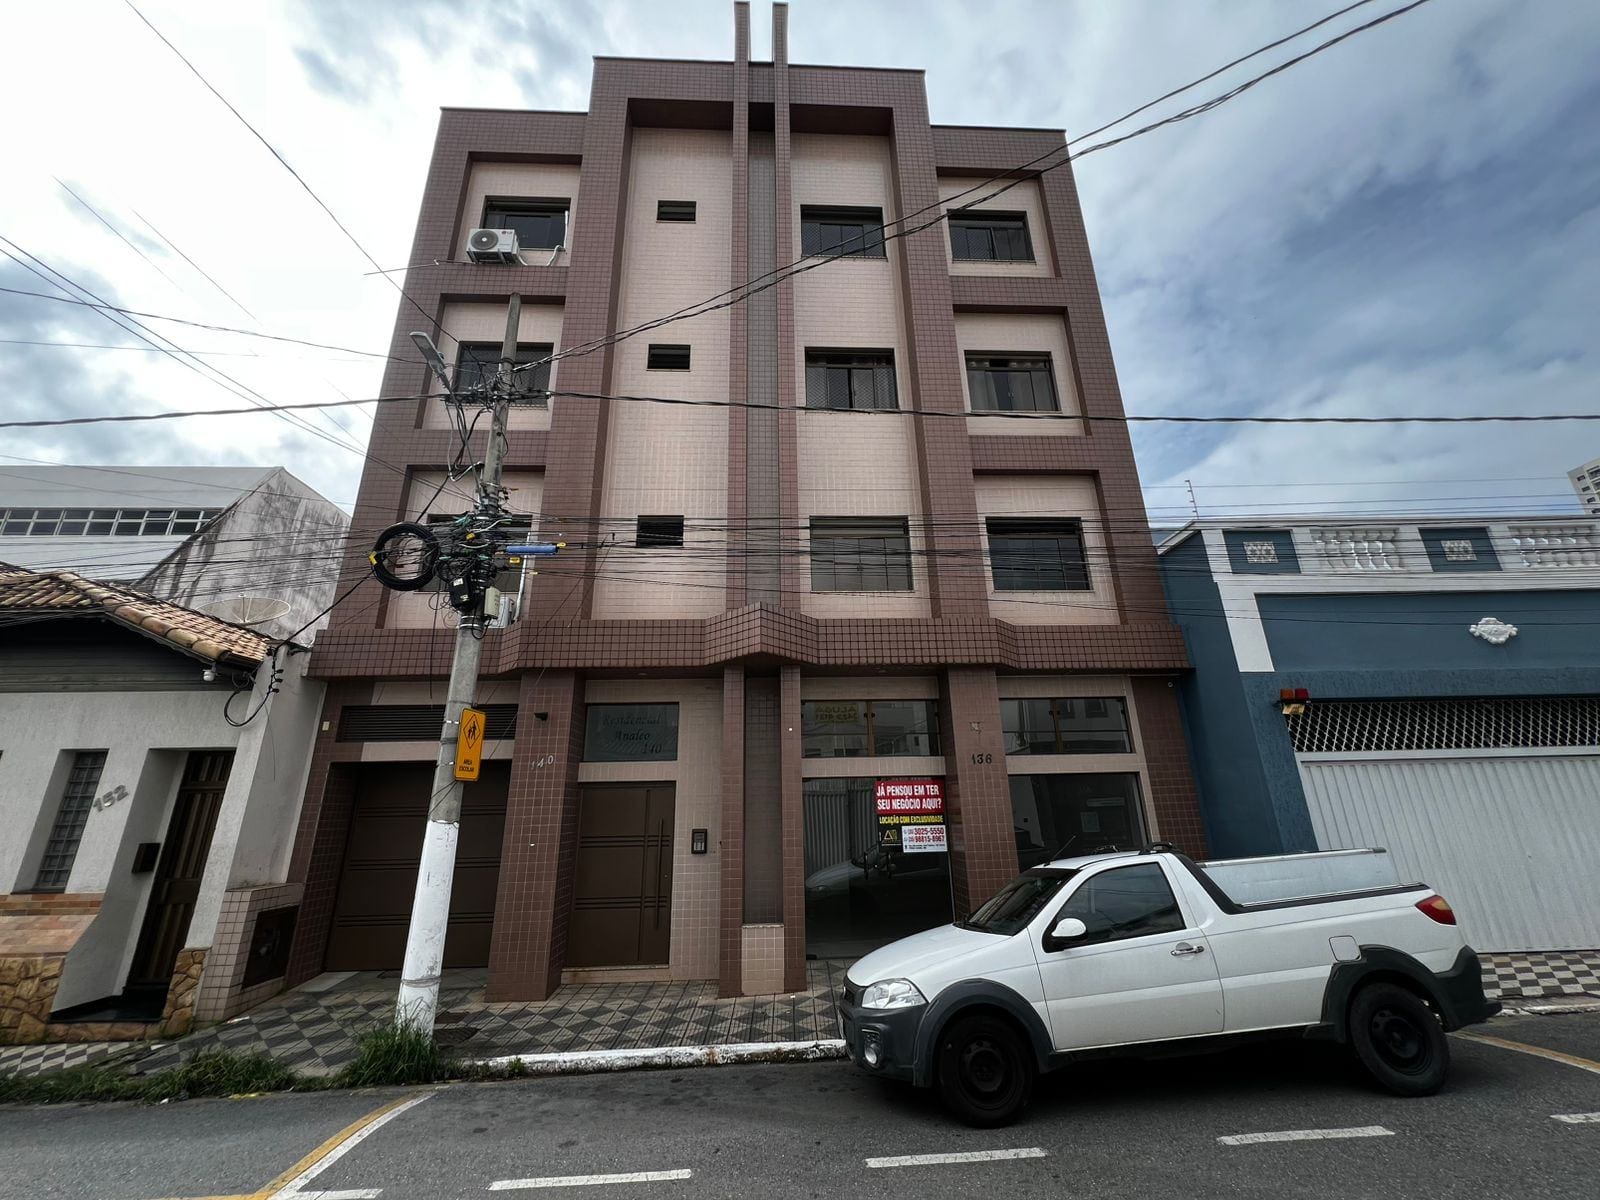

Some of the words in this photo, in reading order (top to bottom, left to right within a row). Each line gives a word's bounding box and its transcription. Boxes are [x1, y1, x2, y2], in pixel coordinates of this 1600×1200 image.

[531, 755, 554, 770] 140
[972, 753, 992, 765] 136
[877, 783, 885, 796] JÁ
[886, 785, 913, 796] PENSOU
[914, 784, 925, 796] EM
[926, 784, 939, 796] TER
[93, 784, 129, 812] 152
[877, 798, 891, 810] SEU
[891, 796, 921, 810] NEGÓCIO
[922, 798, 942, 810] AQUI?
[879, 815, 900, 826] LOCAÇÃO
